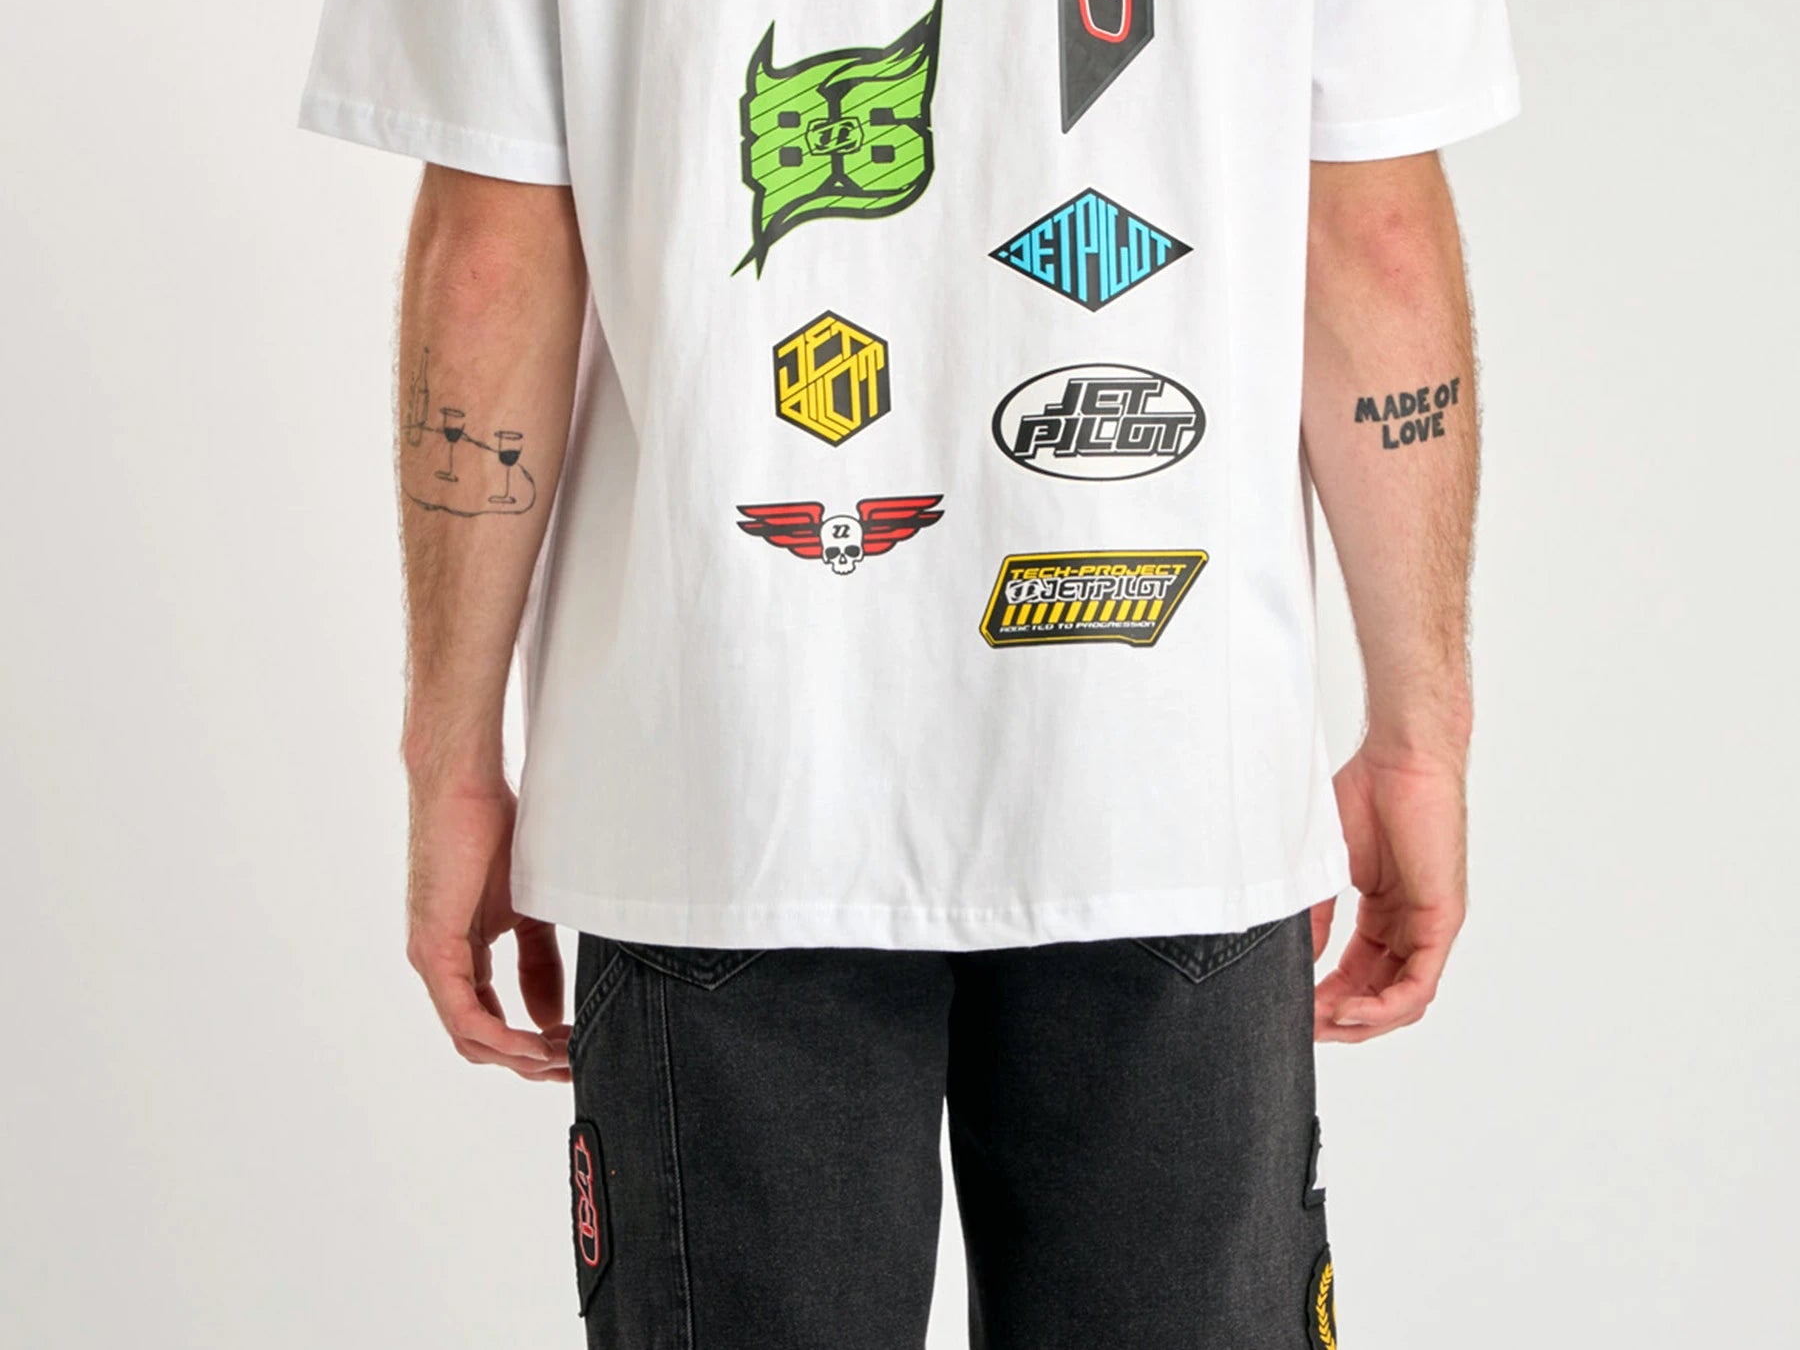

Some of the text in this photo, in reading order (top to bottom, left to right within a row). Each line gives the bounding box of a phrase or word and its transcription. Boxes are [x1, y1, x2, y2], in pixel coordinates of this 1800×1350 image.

[742, 40, 934, 225] 86
[998, 192, 1172, 302] JETPILOT
[777, 315, 874, 402] JET
[1045, 377, 1164, 417] JET
[1354, 376, 1460, 424] MADE OF
[1014, 415, 1196, 458] PILOT
[1382, 410, 1446, 450] LOVE
[1010, 563, 1187, 580] TECH-PROJECT
[1040, 575, 1177, 602] JETPILOT
[1057, 622, 1073, 630] TO
